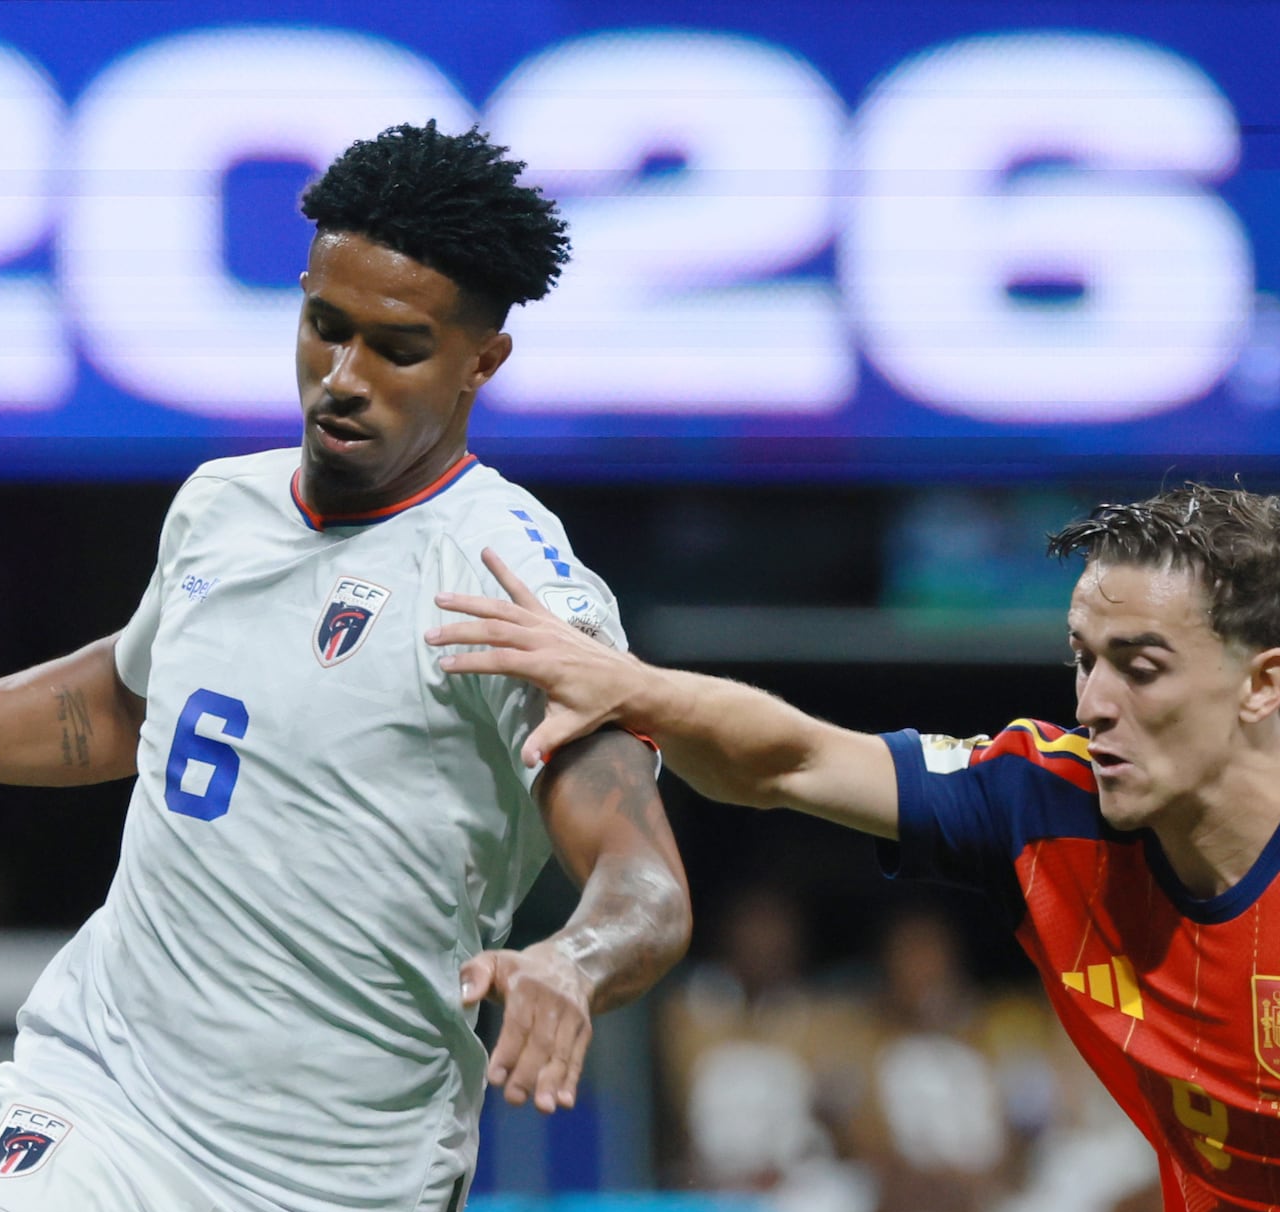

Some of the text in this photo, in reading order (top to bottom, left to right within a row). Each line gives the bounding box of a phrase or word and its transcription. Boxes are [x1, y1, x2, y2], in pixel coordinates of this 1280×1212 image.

[336, 582, 384, 600] FCF
[164, 688, 249, 822] 6
[12, 1110, 65, 1128] FCF
[1167, 1078, 1232, 1170] 9
